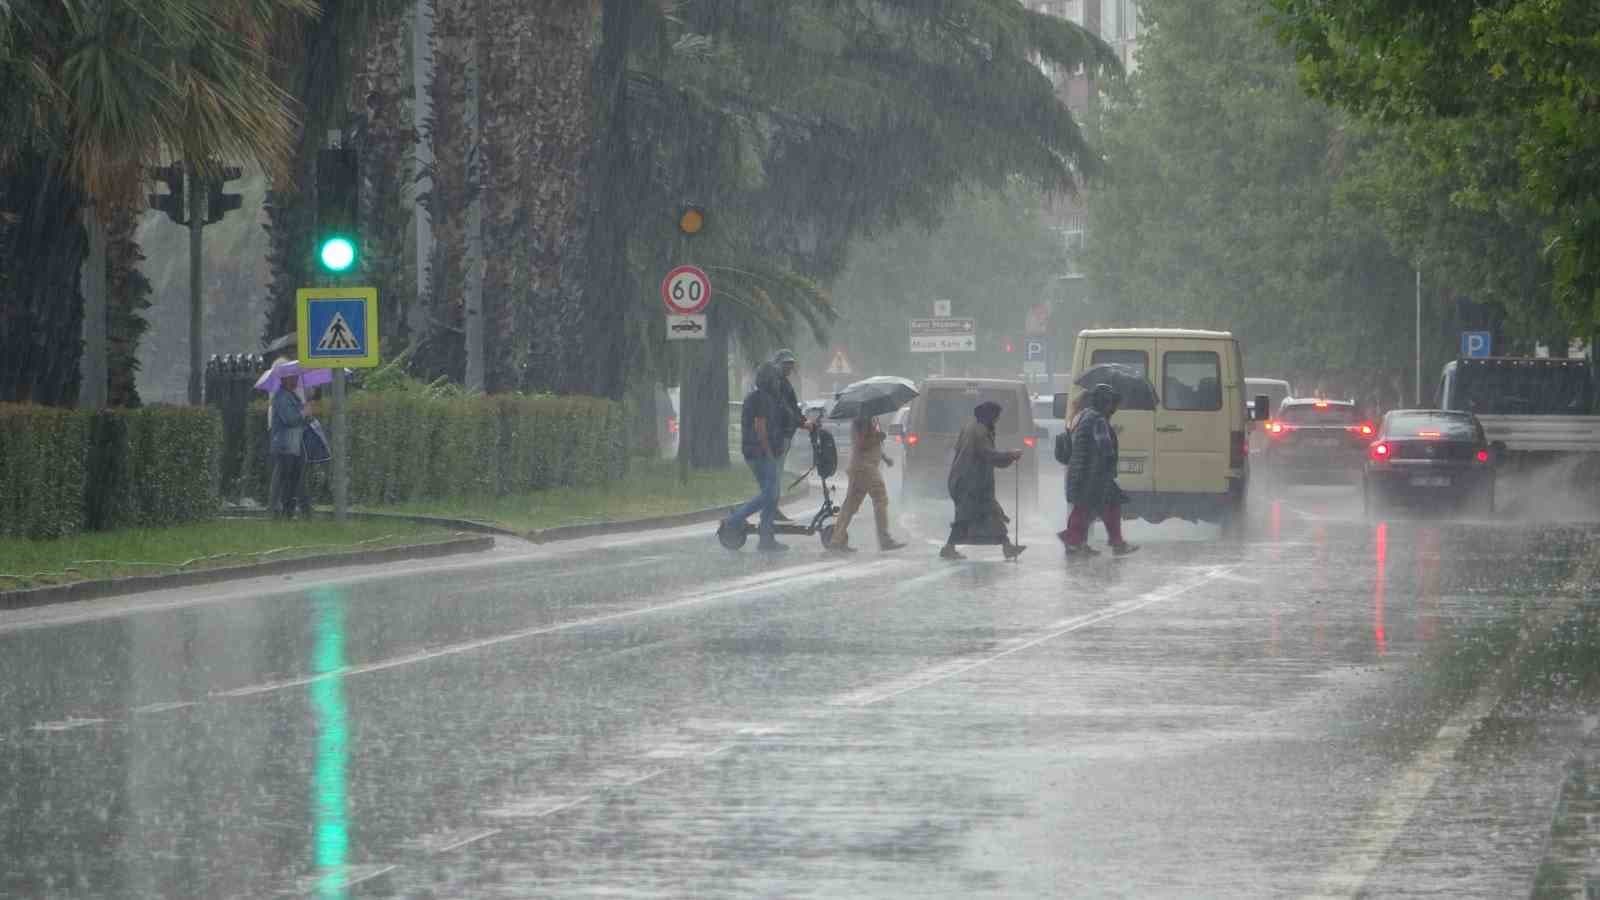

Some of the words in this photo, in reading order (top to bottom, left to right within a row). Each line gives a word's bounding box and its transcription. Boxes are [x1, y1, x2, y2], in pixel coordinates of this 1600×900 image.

[672, 280, 701, 301] 60
[1028, 342, 1042, 360] P
[1469, 335, 1484, 356] P
